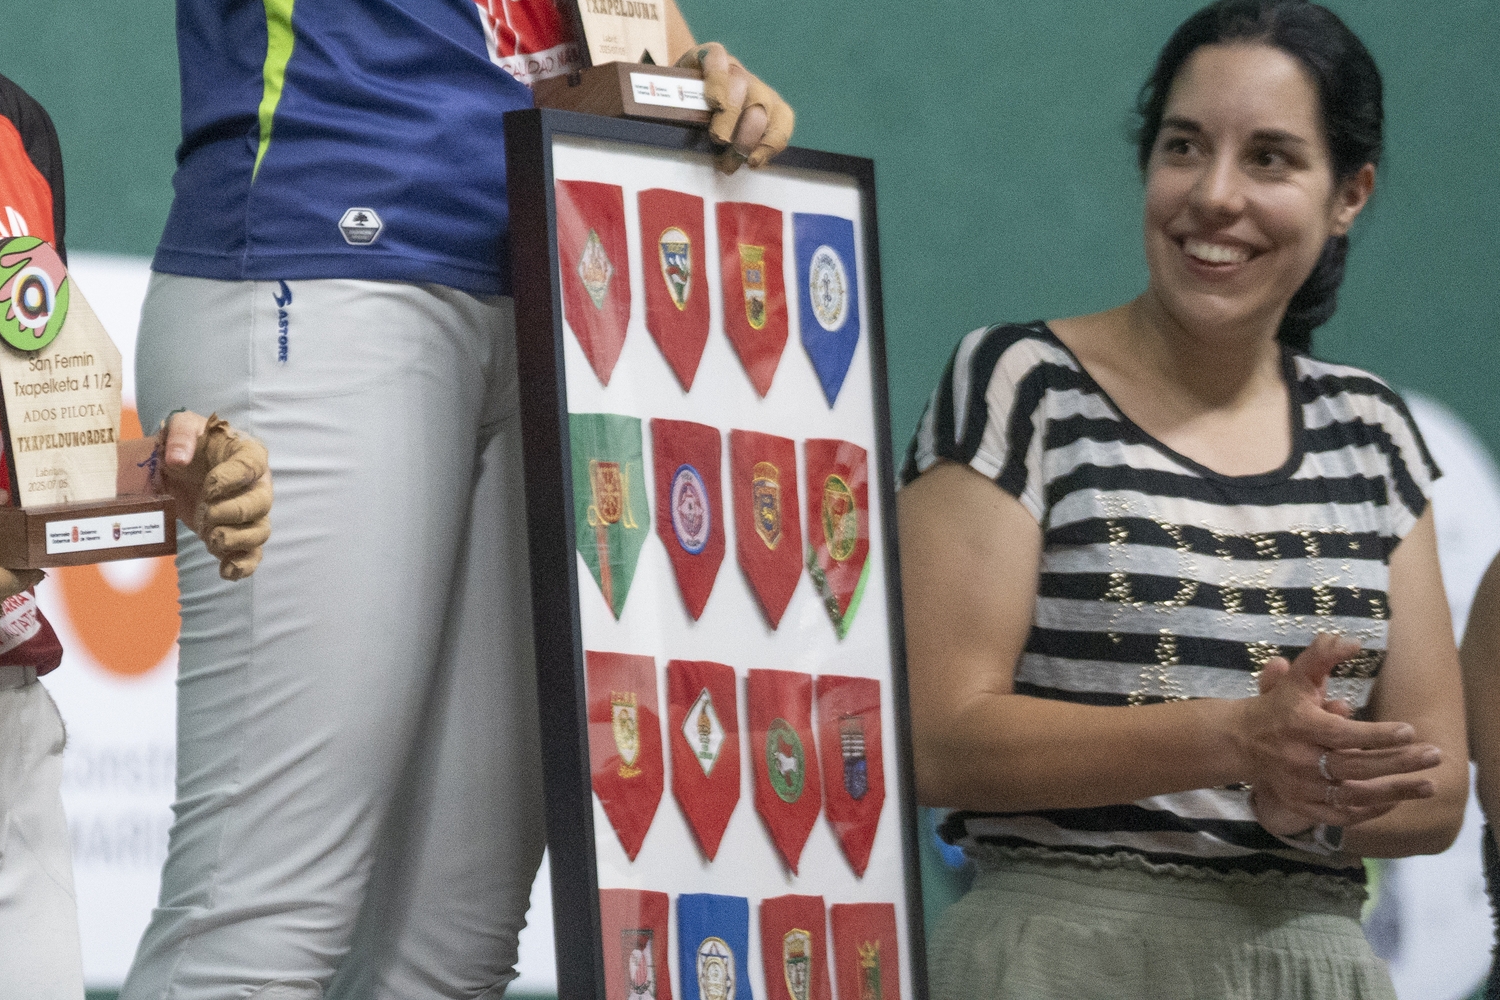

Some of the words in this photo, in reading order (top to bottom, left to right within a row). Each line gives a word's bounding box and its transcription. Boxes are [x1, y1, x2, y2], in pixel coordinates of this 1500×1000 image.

[28, 356, 52, 373] San
[54, 352, 94, 369] Fermin
[13, 377, 79, 399] Txapelketa
[82, 375, 90, 390] 4
[94, 372, 112, 391] 1/2
[23, 408, 57, 423] ADOS
[60, 404, 105, 420] PILOTA
[17, 428, 115, 453] TXAPELDUNORDEA
